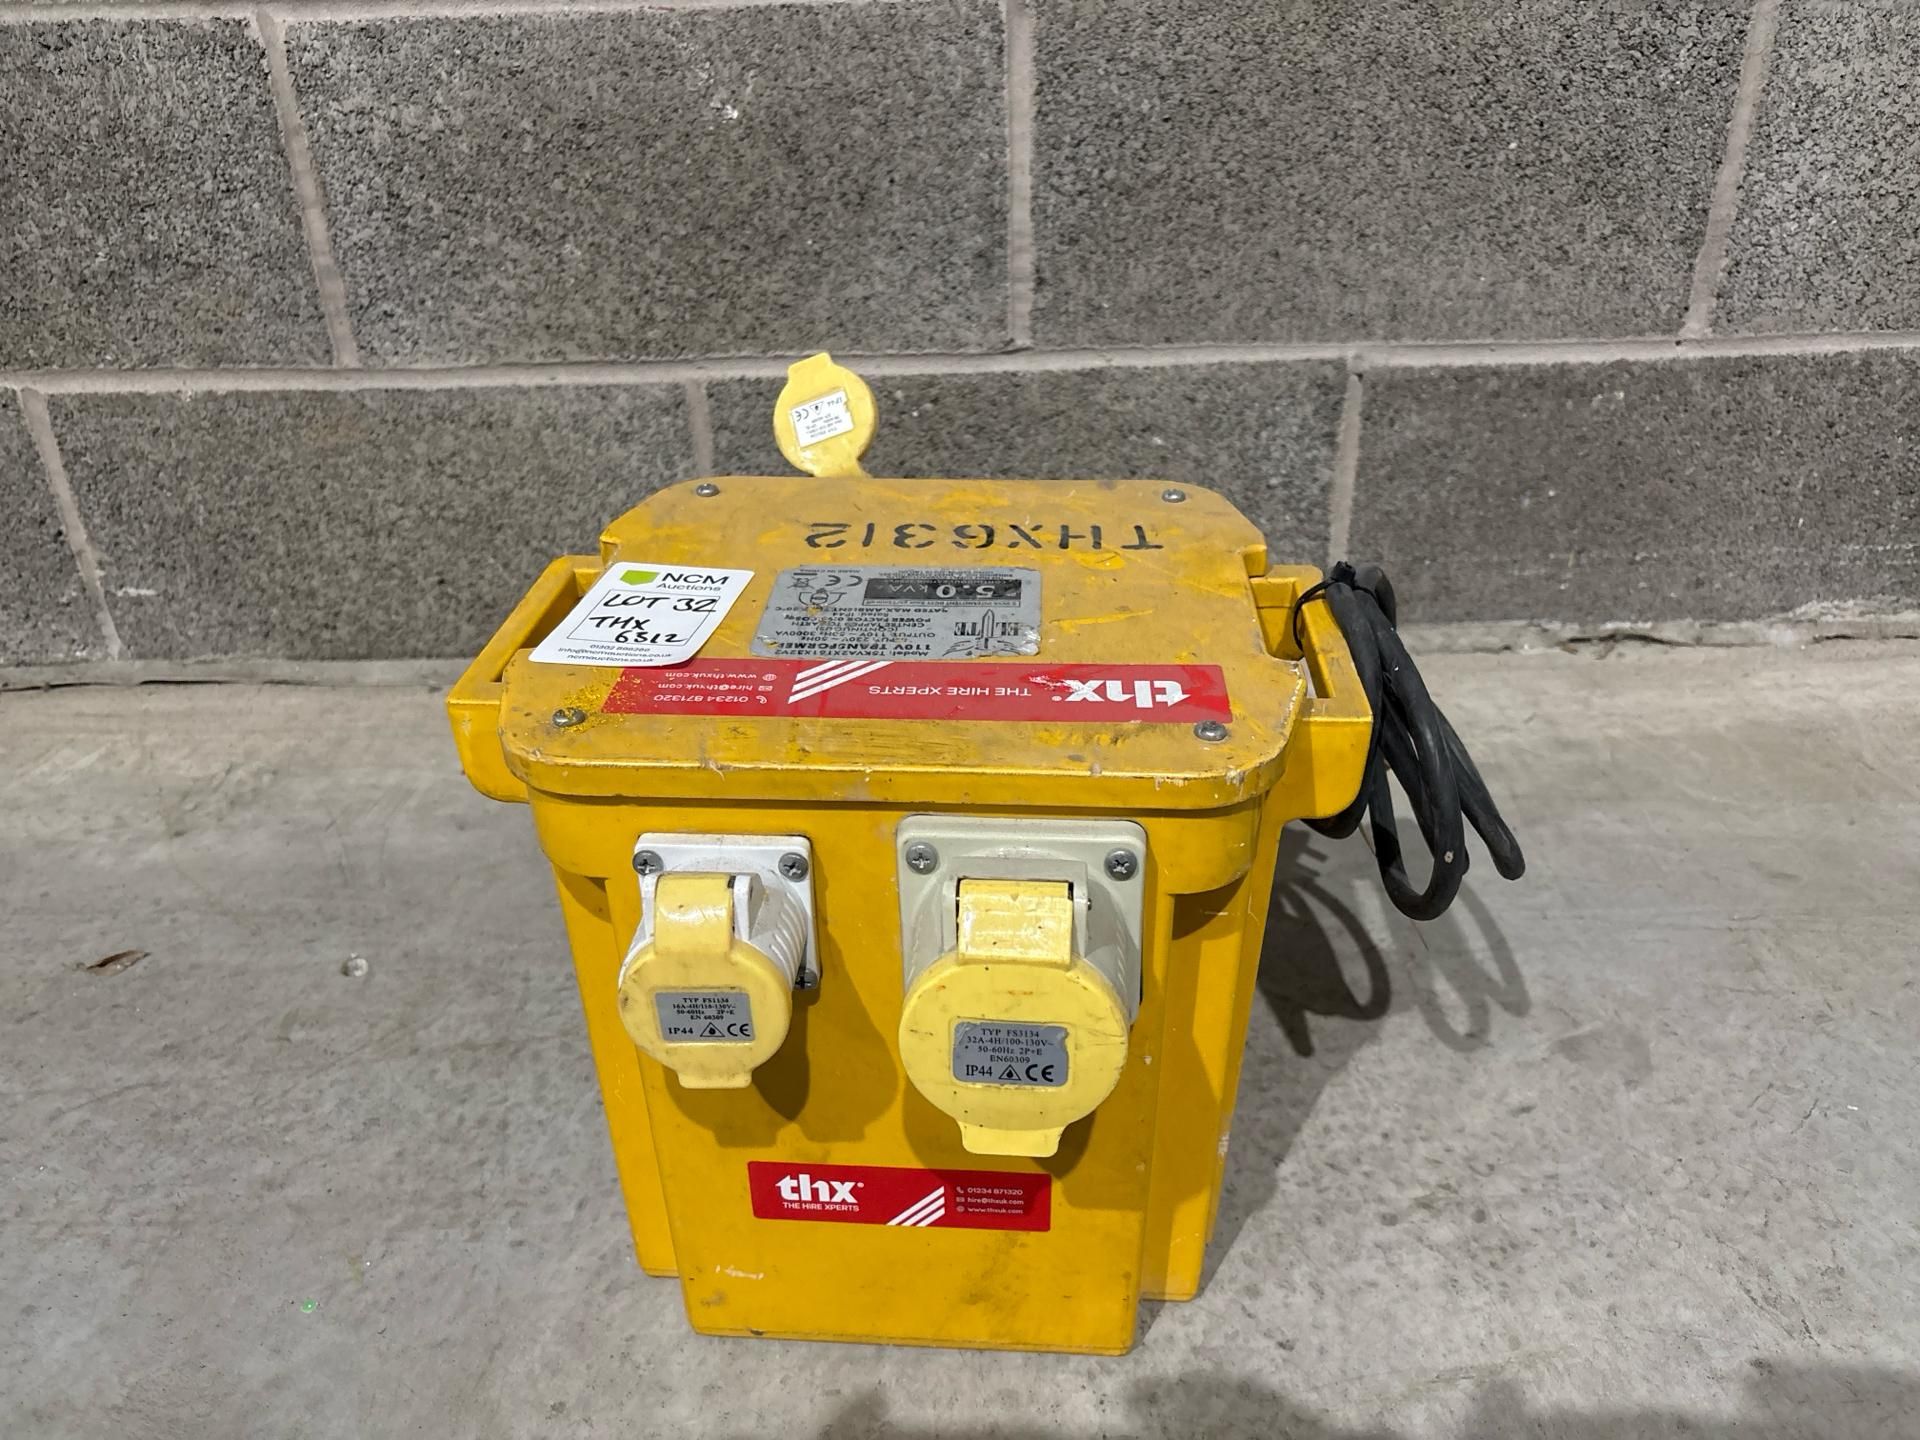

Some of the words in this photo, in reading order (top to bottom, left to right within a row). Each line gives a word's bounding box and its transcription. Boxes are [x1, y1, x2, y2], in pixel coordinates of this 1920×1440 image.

[804, 523, 1164, 550] THX6312
[662, 572, 730, 585] NCM
[656, 583, 722, 592] Auctions
[603, 593, 670, 609] LOT
[672, 598, 719, 613] 32
[589, 616, 651, 630] THX
[614, 630, 686, 644] 6312
[665, 672, 757, 680] www.thxuk.com
[868, 685, 942, 696] XPERTS
[946, 686, 989, 696] HIRE
[994, 687, 1031, 696] THE
[653, 694, 704, 703] 871320
[707, 695, 749, 703] 01234
[668, 1027, 694, 1035] IP44
[981, 1028, 1001, 1036] TYP
[1007, 1029, 1039, 1038] FS3134
[977, 1045, 1015, 1055] 50-60Hz
[1019, 1047, 1043, 1056] 2P+E
[990, 1055, 1031, 1064] EN60309
[965, 1064, 993, 1077] IP44
[993, 1188, 1023, 1196] 871320
[802, 1202, 823, 1210] HIRE
[824, 1203, 860, 1212] XPERTS
